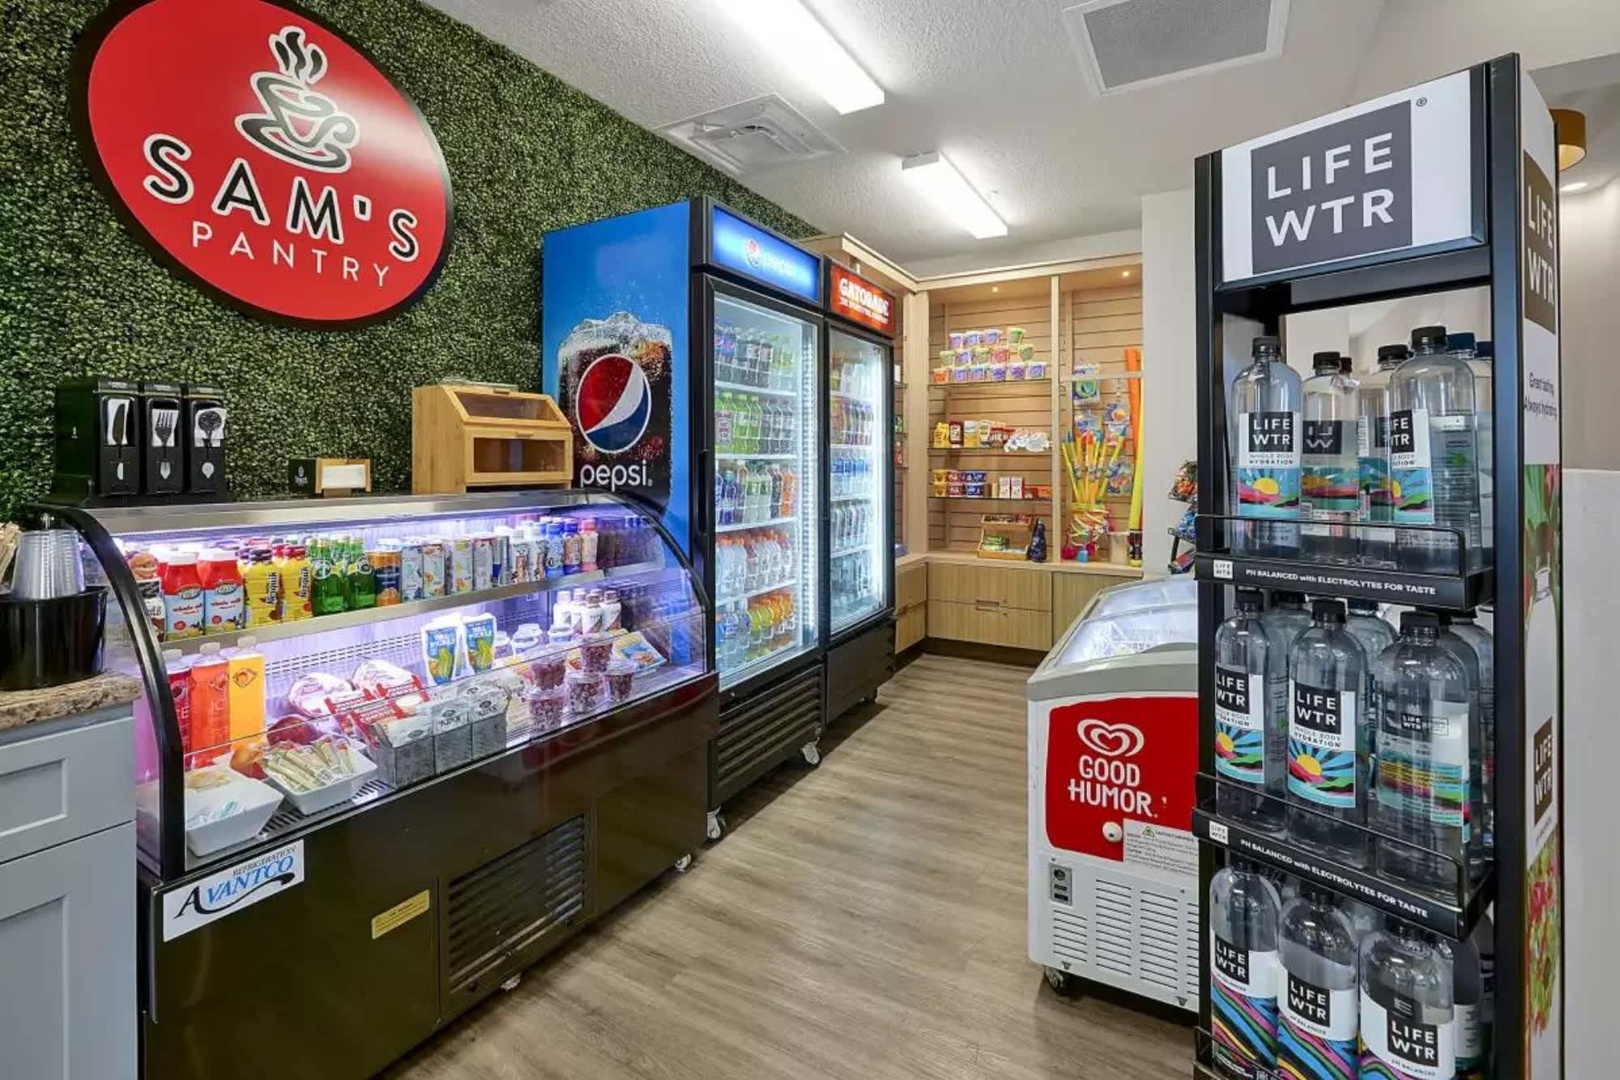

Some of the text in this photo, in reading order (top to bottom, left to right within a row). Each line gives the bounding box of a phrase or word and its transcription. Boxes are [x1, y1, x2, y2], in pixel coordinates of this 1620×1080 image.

[1267, 132, 1394, 200] LIFE
[142, 133, 420, 262] SAM'S
[1265, 188, 1394, 247] WTR
[1528, 184, 1554, 249] LIFE
[192, 220, 390, 288] PANTRY
[1527, 247, 1556, 306] WTR
[1253, 418, 1290, 430] LIFE
[1252, 433, 1290, 445] WTR
[579, 460, 648, 492] pepsi
[1245, 568, 1436, 596] PH BALANCED with ELECTROLYTES FOR TASTE
[1217, 673, 1246, 692] LIFE
[1217, 688, 1246, 708] WTR
[1296, 689, 1337, 711] LIFE
[1296, 704, 1337, 727] WTR
[1078, 754, 1141, 788] GOOD
[1067, 777, 1153, 818] HUMOR
[174, 855, 295, 919] AVANTCO
[1240, 838, 1429, 919] PH BALANCED with ELECTROLYTES FOR TASTE
[1216, 940, 1246, 966] LIFE
[1216, 952, 1246, 979] WTR
[1289, 992, 1327, 1021] WTR
[1290, 979, 1327, 1007] LIFE
[1391, 1019, 1435, 1045] LIFE
[1391, 1034, 1436, 1060] WTR
